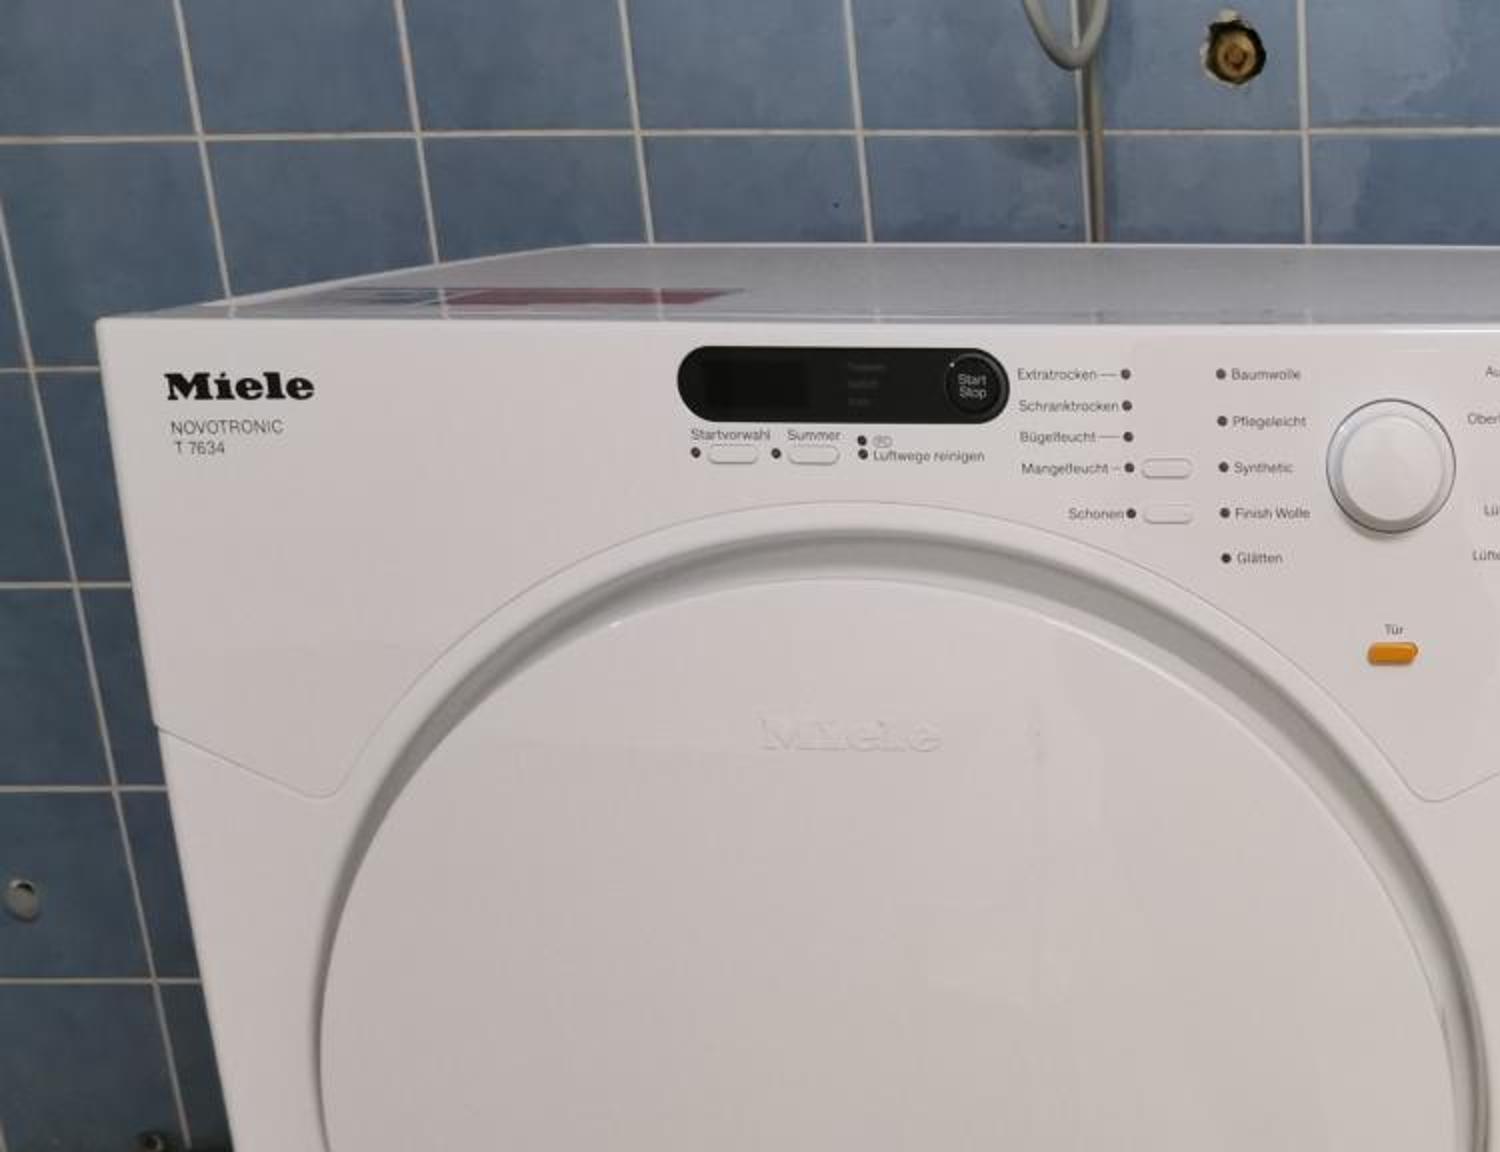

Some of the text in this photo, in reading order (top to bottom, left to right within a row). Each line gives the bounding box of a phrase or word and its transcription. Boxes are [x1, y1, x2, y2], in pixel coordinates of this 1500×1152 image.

[957, 373, 987, 386] Start
[1017, 367, 1097, 380] Extratrocken
[1231, 367, 1301, 380] Baumwolle
[164, 371, 314, 400] Miele
[959, 386, 987, 400] Stop
[1018, 400, 1118, 413] Schranktrocken
[171, 418, 284, 436] NOVOTRONIC
[1232, 416, 1306, 430] Pflegeleicht
[690, 428, 771, 442] Startvorwahl
[788, 428, 841, 442] Summer
[1020, 430, 1096, 446] Bügelfeucht
[174, 441, 225, 455] T 7634
[873, 449, 985, 464] Luftwege reinigen
[1021, 462, 1109, 477] Mangelfeucht
[1234, 462, 1293, 475] Synthetic
[1068, 507, 1124, 520] Schonen
[1235, 507, 1310, 520] Finish Wolle
[1236, 551, 1283, 564] Glätten
[1384, 623, 1404, 636] Tür
